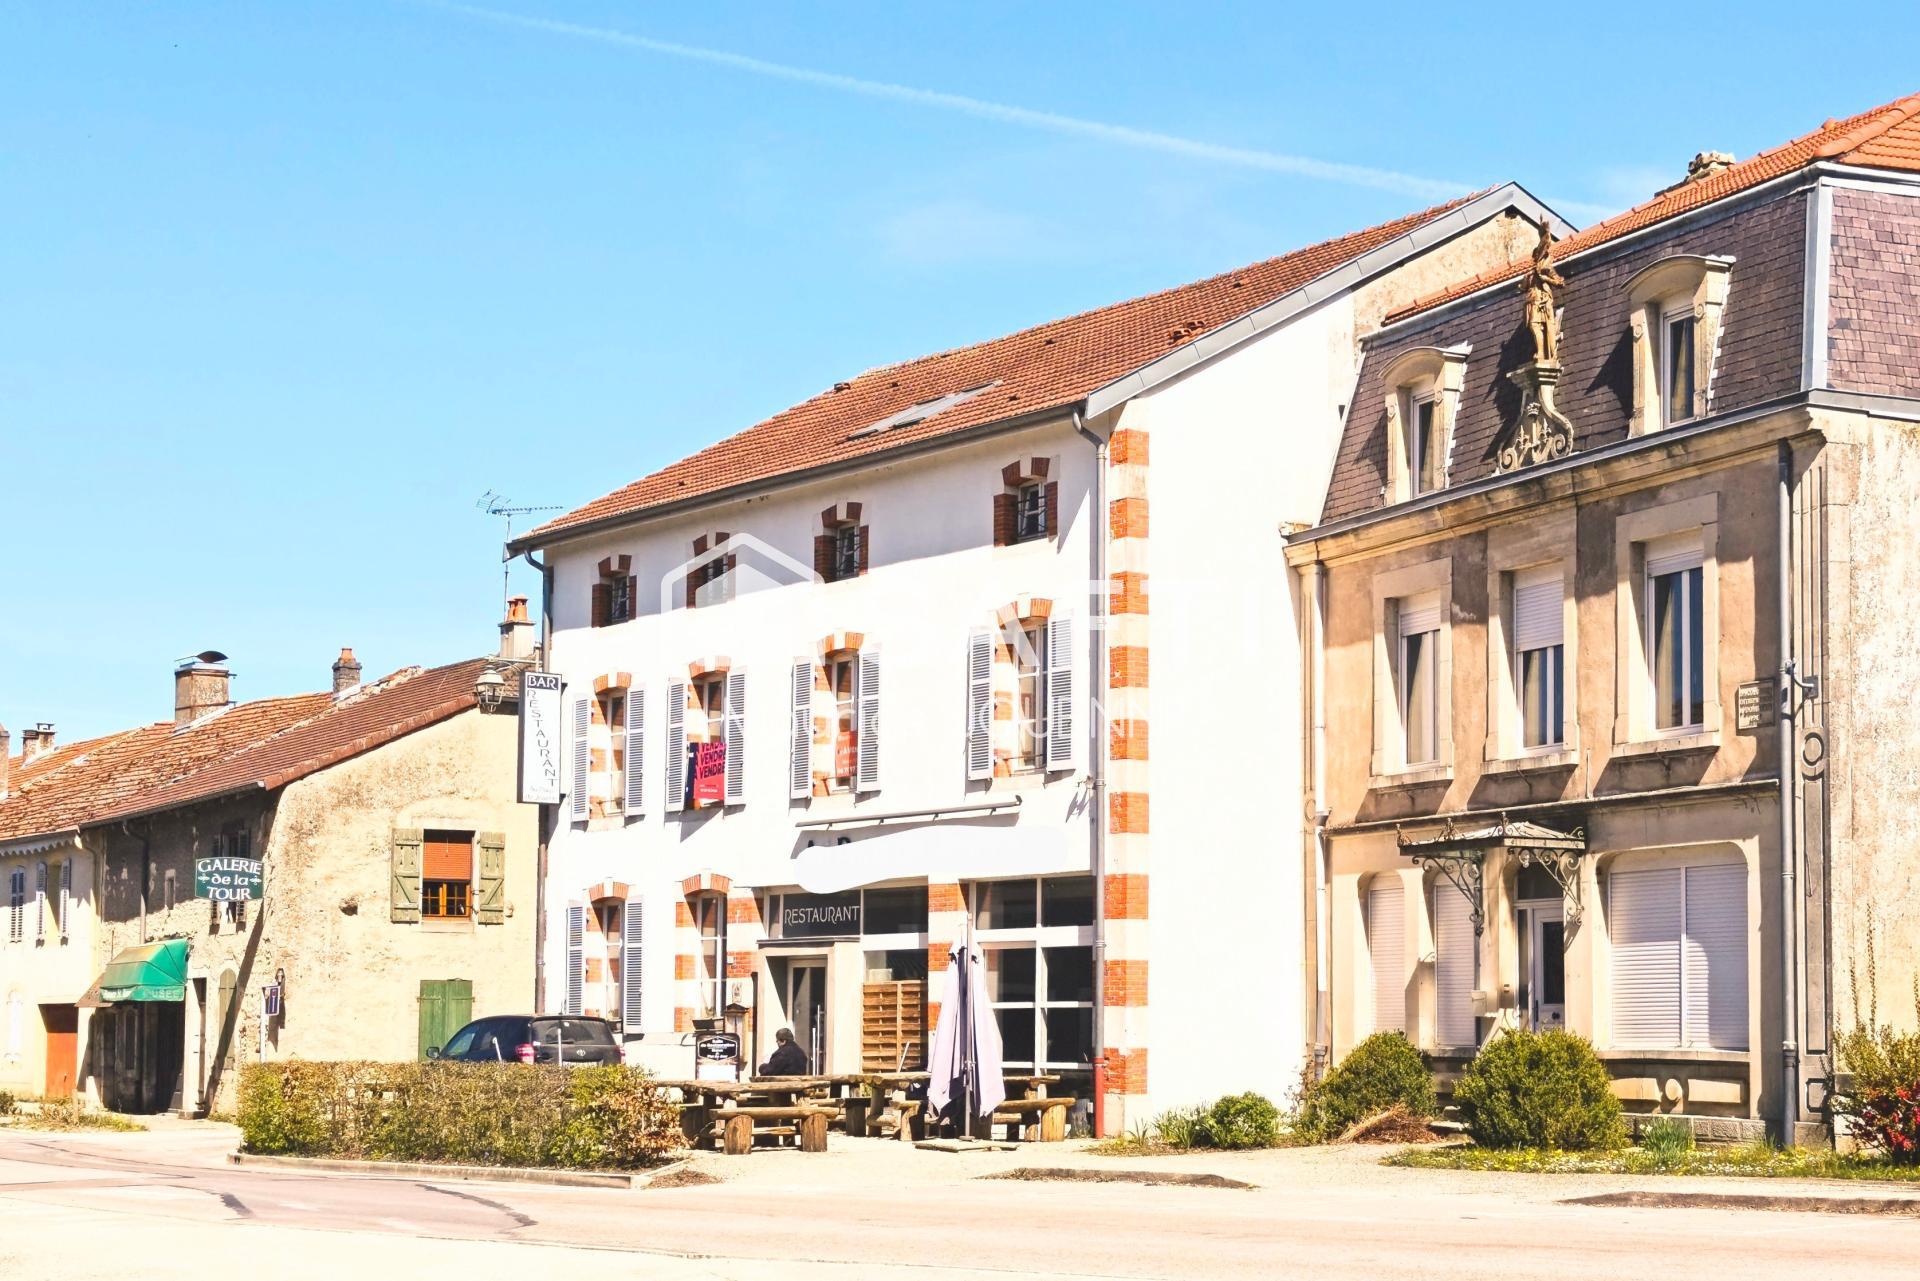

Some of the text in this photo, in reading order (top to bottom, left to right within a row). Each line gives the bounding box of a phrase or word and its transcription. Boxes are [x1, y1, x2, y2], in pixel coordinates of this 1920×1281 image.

[527, 675, 558, 691] BAR
[526, 689, 558, 788] RESTAURANT
[197, 858, 263, 876] GALERIE
[211, 873, 249, 886] de la
[206, 886, 253, 900] TOUR
[784, 905, 860, 927] RESTAURANT
